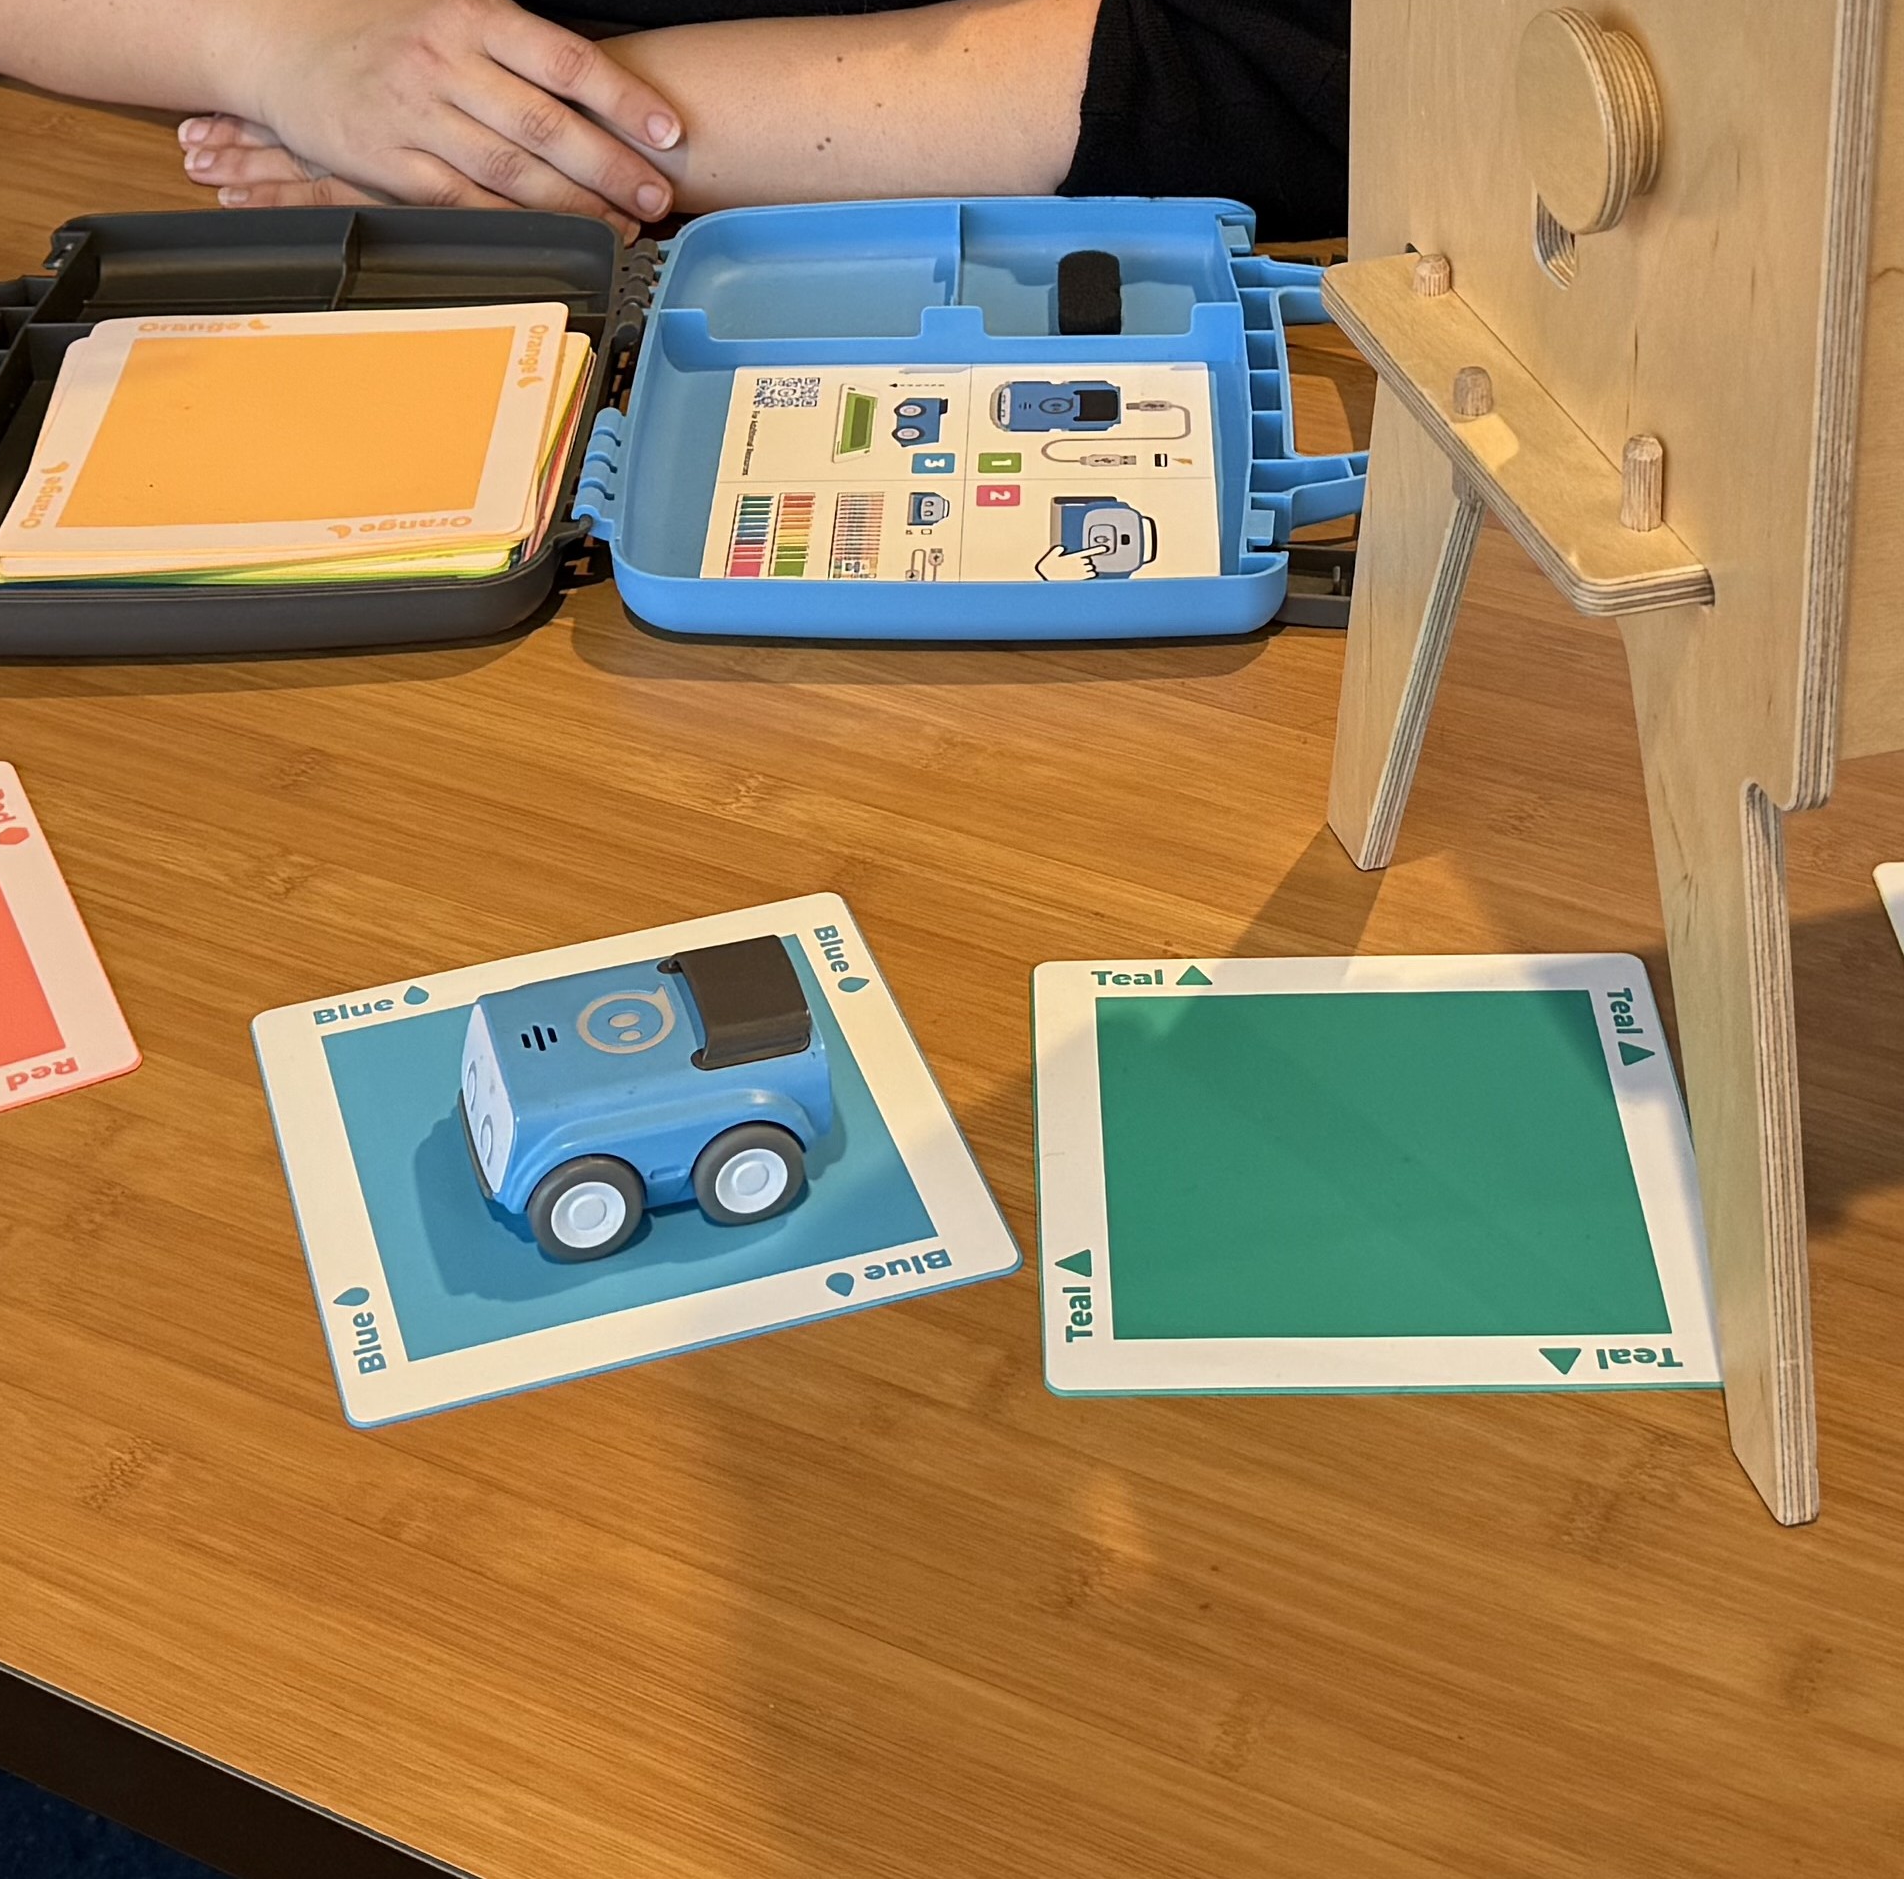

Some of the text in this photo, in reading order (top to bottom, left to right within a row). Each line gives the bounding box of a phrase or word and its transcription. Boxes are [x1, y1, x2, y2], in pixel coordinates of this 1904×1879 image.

[137, 320, 241, 334] Orange
[518, 324, 549, 376] Orange
[924, 458, 945, 468] 3
[20, 476, 62, 529] Orange
[989, 490, 1011, 501] 2
[359, 516, 473, 533] Orange
[814, 924, 850, 974] Blue
[1091, 969, 1165, 986] Teal
[312, 995, 395, 1026] Blue
[1607, 987, 1644, 1035] Teal
[5, 1057, 78, 1092] Red
[863, 1248, 952, 1281] Blue
[1063, 1285, 1095, 1343] Teal
[353, 1309, 387, 1375] Blue
[1597, 1347, 1684, 1369] Teal
